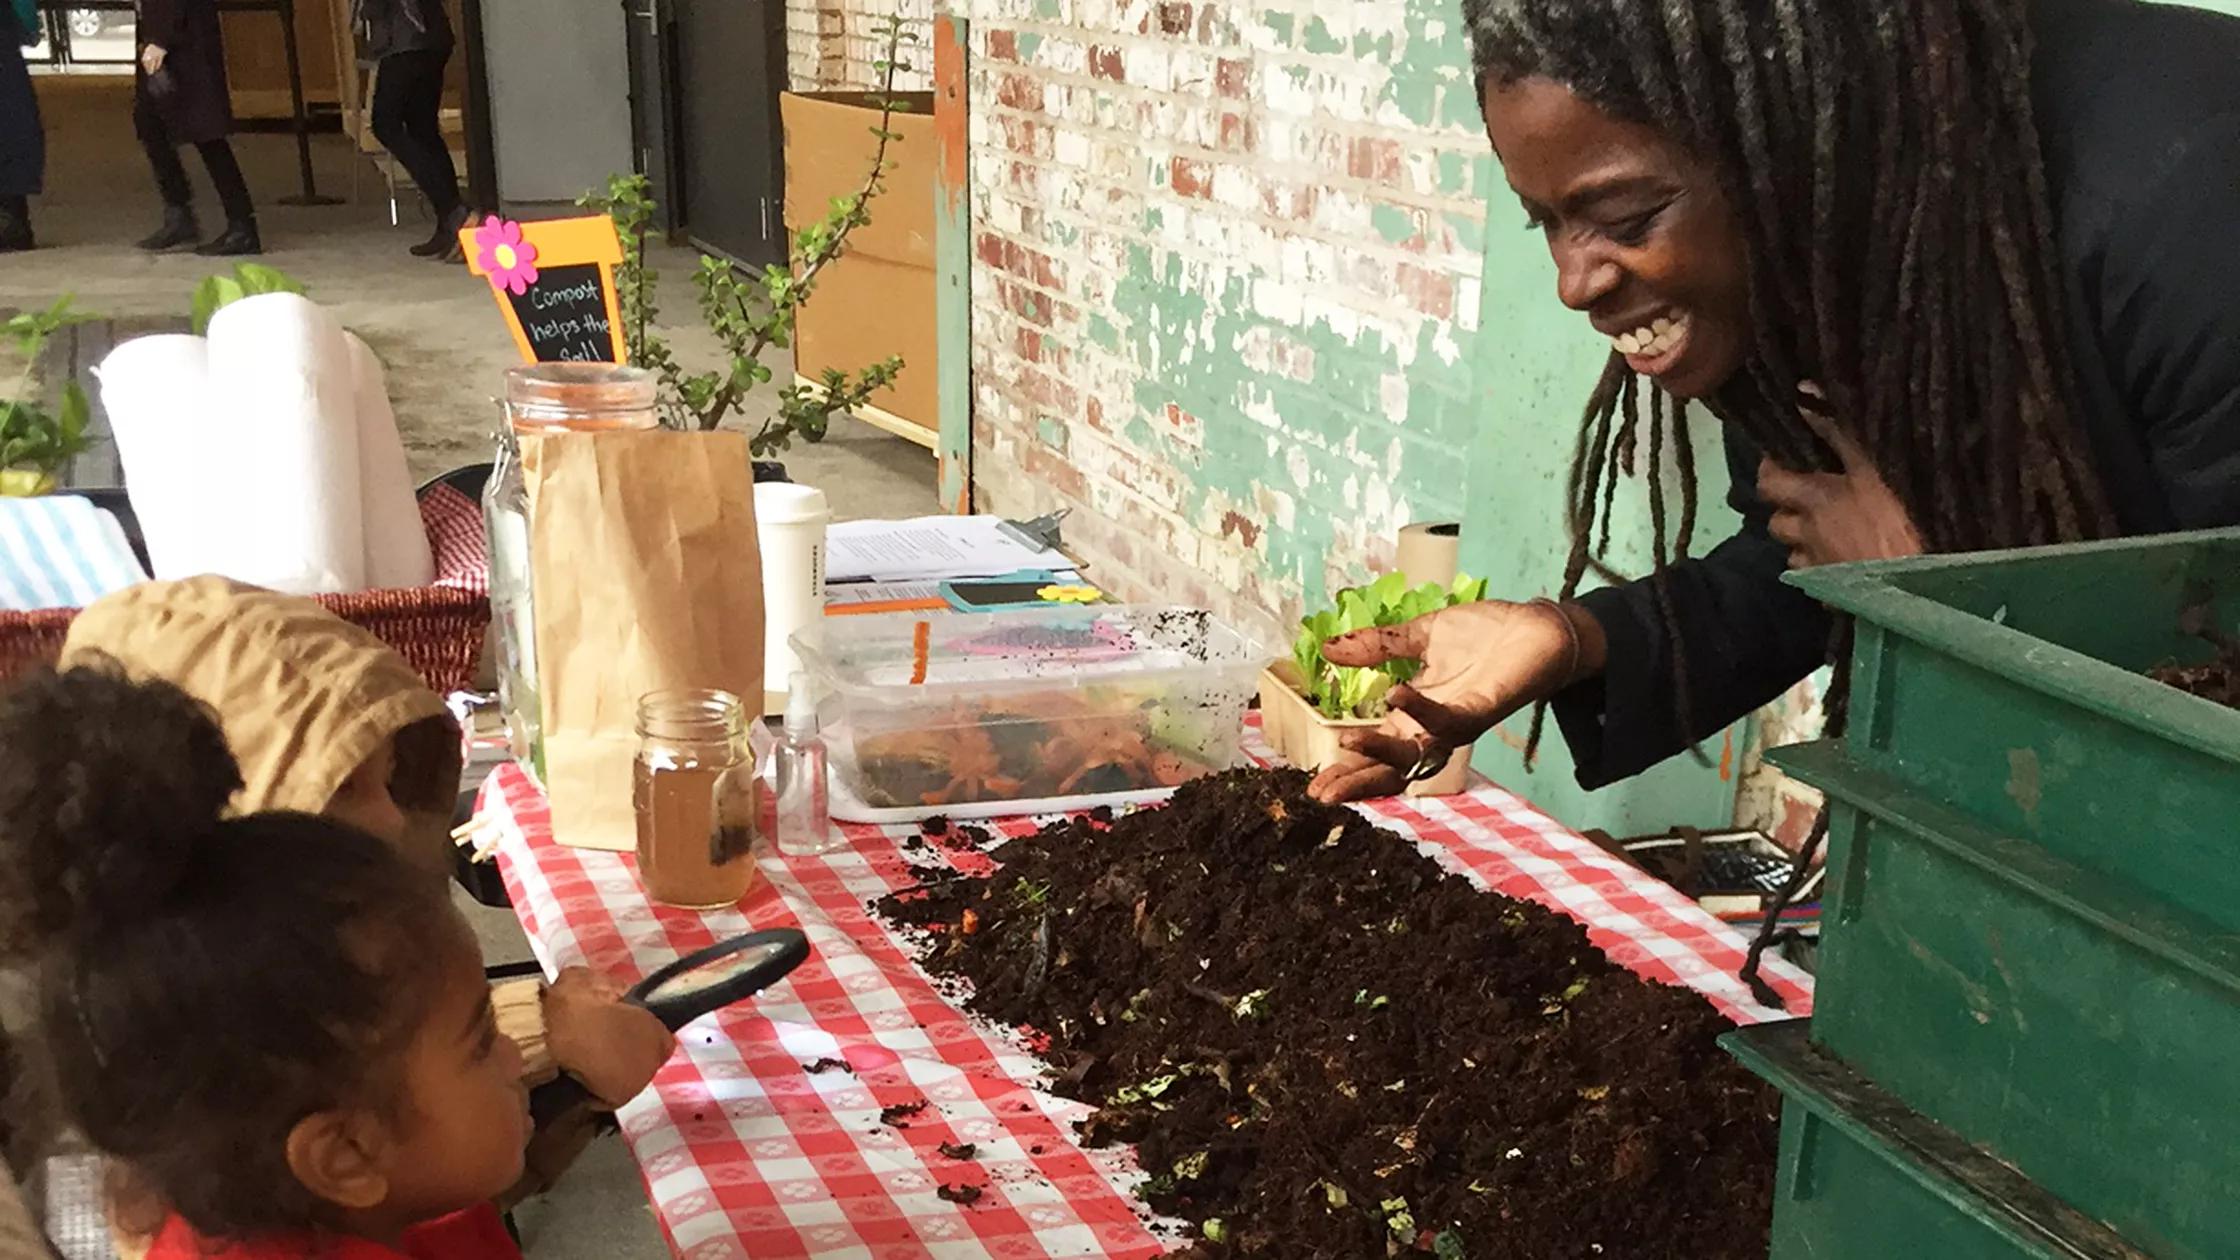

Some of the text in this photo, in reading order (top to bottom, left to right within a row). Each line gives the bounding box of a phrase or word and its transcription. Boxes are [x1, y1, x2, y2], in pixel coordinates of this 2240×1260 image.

[531, 279, 599, 310] Compost
[529, 313, 610, 342] helps the
